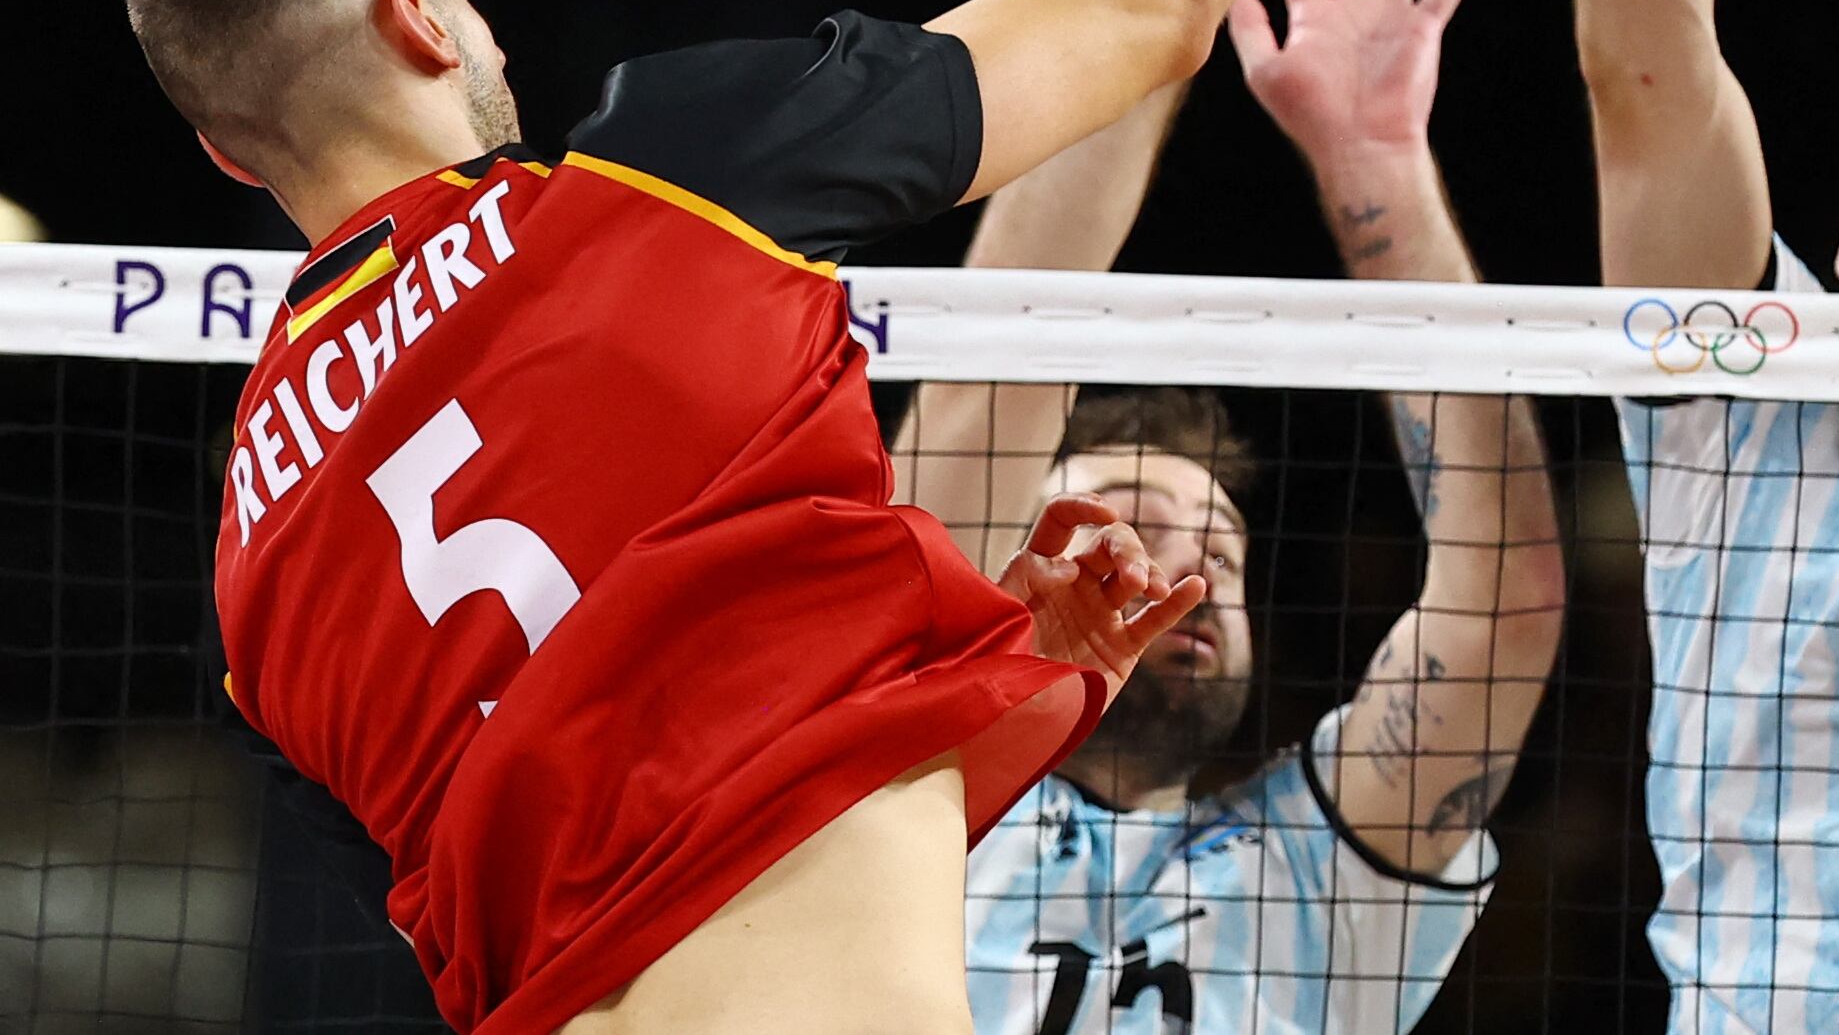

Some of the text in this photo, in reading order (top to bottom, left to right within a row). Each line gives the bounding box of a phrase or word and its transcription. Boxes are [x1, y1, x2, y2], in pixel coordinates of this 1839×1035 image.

[114, 260, 254, 339] PA
[230, 179, 518, 549] REICHERT
[366, 398, 582, 720] 5
